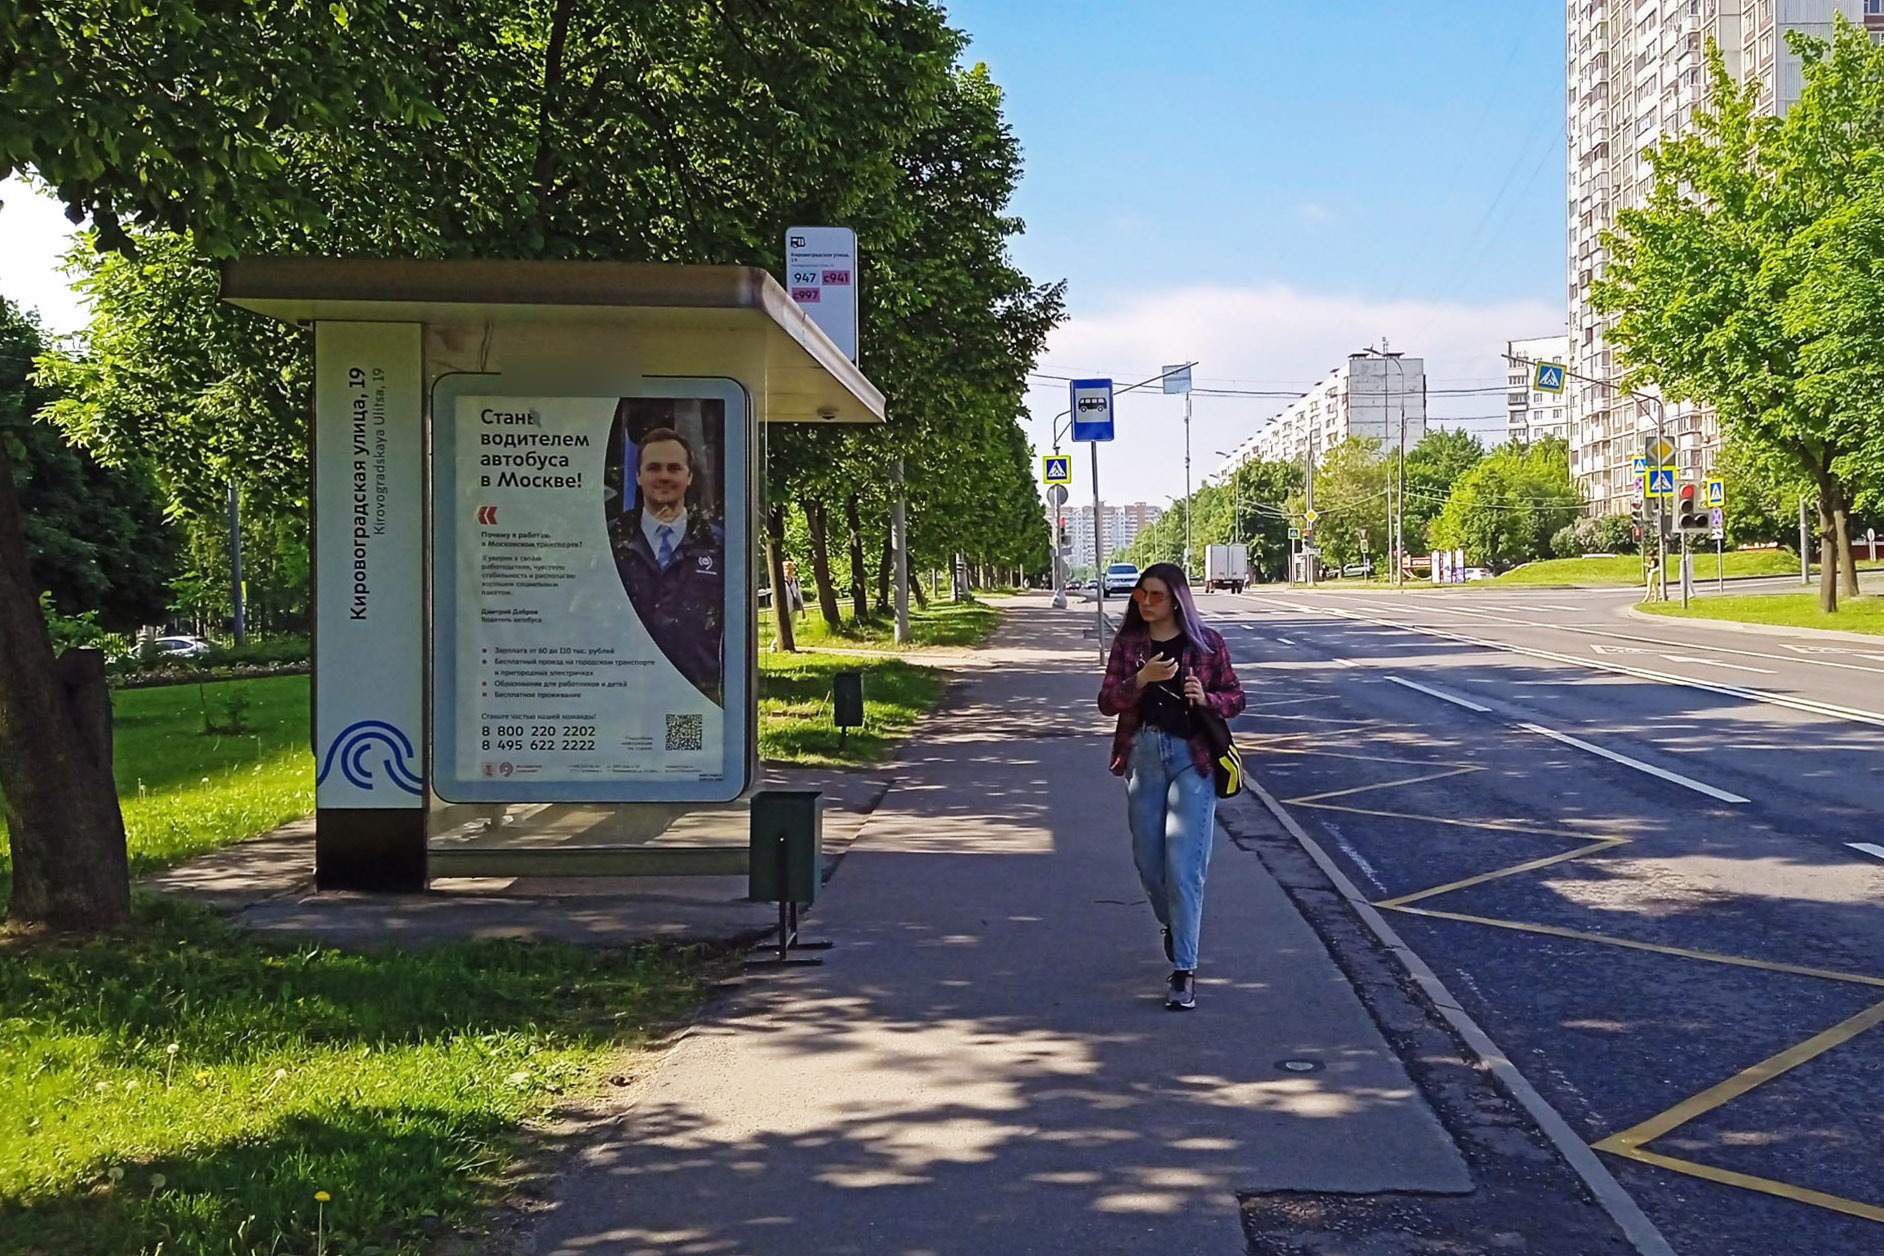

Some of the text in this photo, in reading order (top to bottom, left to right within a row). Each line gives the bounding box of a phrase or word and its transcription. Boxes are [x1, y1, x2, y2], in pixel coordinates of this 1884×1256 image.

[794, 273, 816, 283] 947
[481, 408, 538, 425] Стань
[481, 433, 590, 448] водителем
[372, 368, 388, 535] Kirovogradskaya Ulitsa, 19
[481, 451, 569, 470] автобуса
[481, 471, 582, 488] в Москве!
[349, 367, 370, 620] Кировоградская улица, 19
[494, 647, 527, 655] Зарплата
[588, 647, 615, 656] рублей
[482, 726, 596, 736] 8 800 220 2202
[482, 740, 595, 750] 8 495 622 2222
